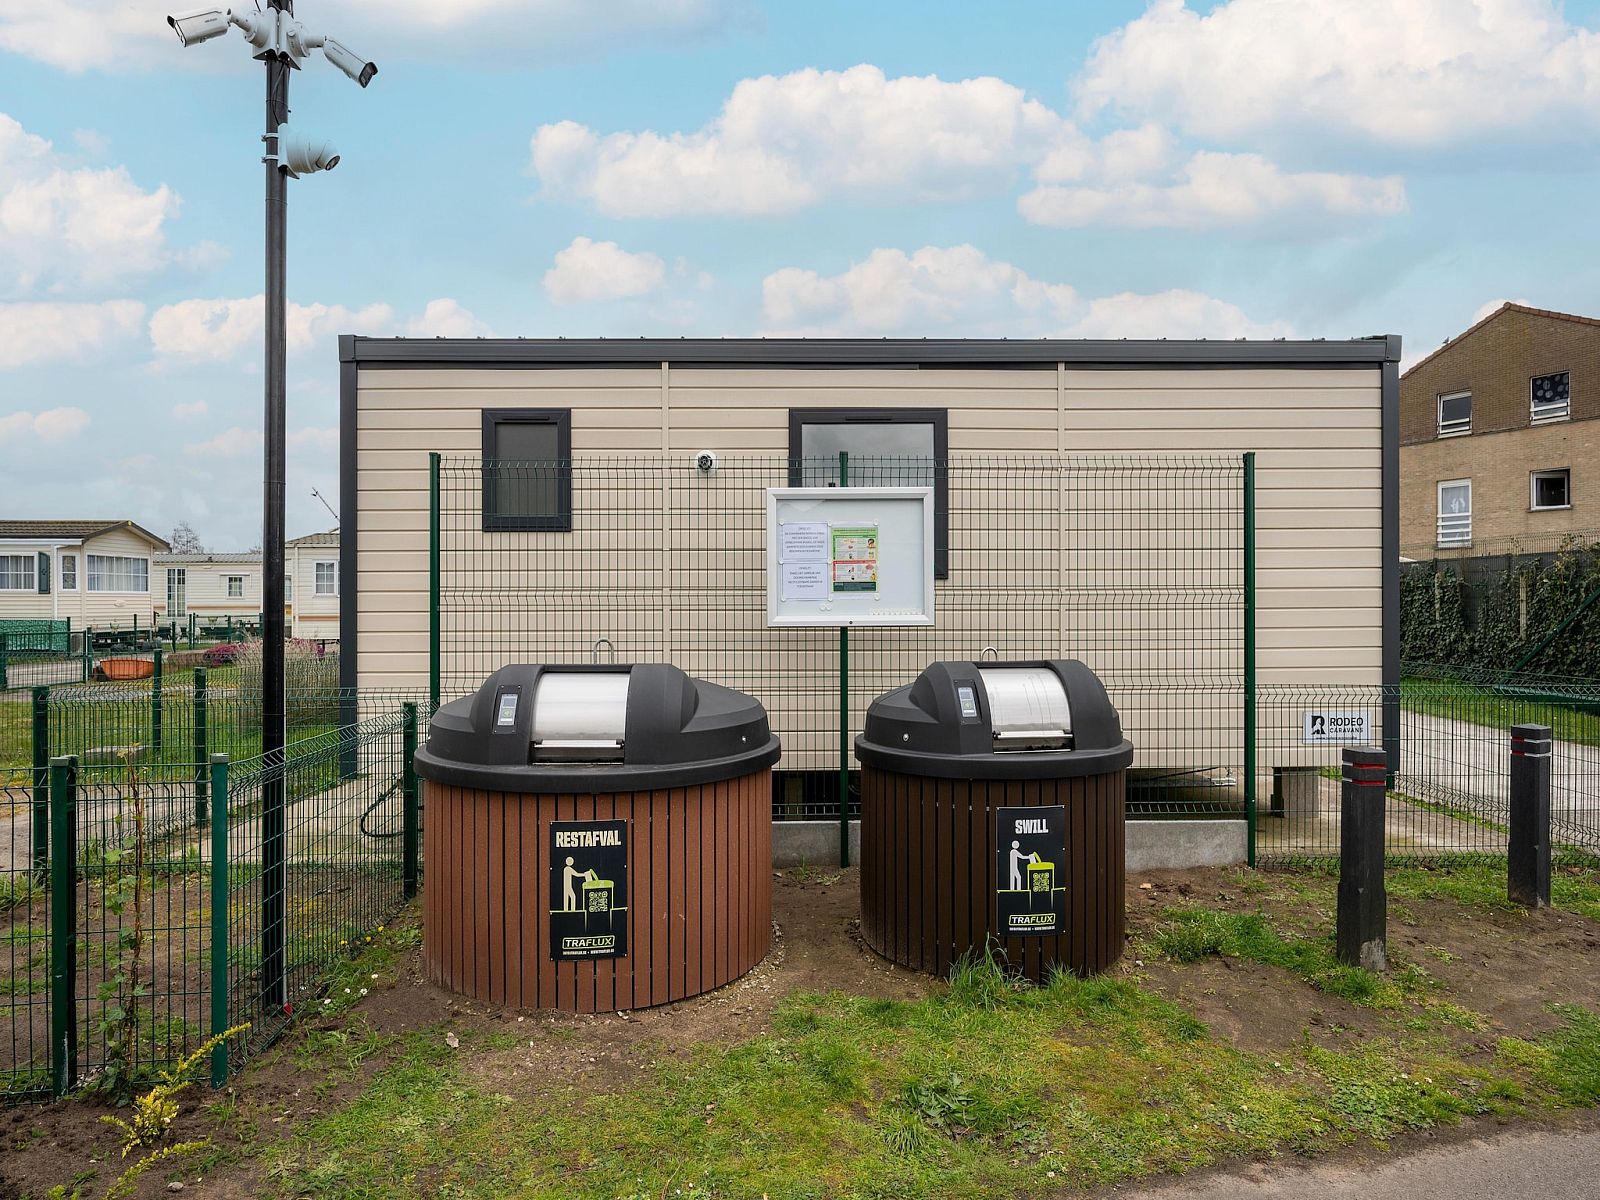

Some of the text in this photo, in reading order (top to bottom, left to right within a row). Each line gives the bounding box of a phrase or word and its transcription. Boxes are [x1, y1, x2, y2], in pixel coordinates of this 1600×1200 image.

[1329, 717, 1364, 727] RODEO
[1015, 819, 1049, 834] SWILL
[555, 830, 622, 848] RESTAFVAL
[1011, 915, 1054, 924] TRAFLUX
[565, 937, 612, 947] TRAFLUX
